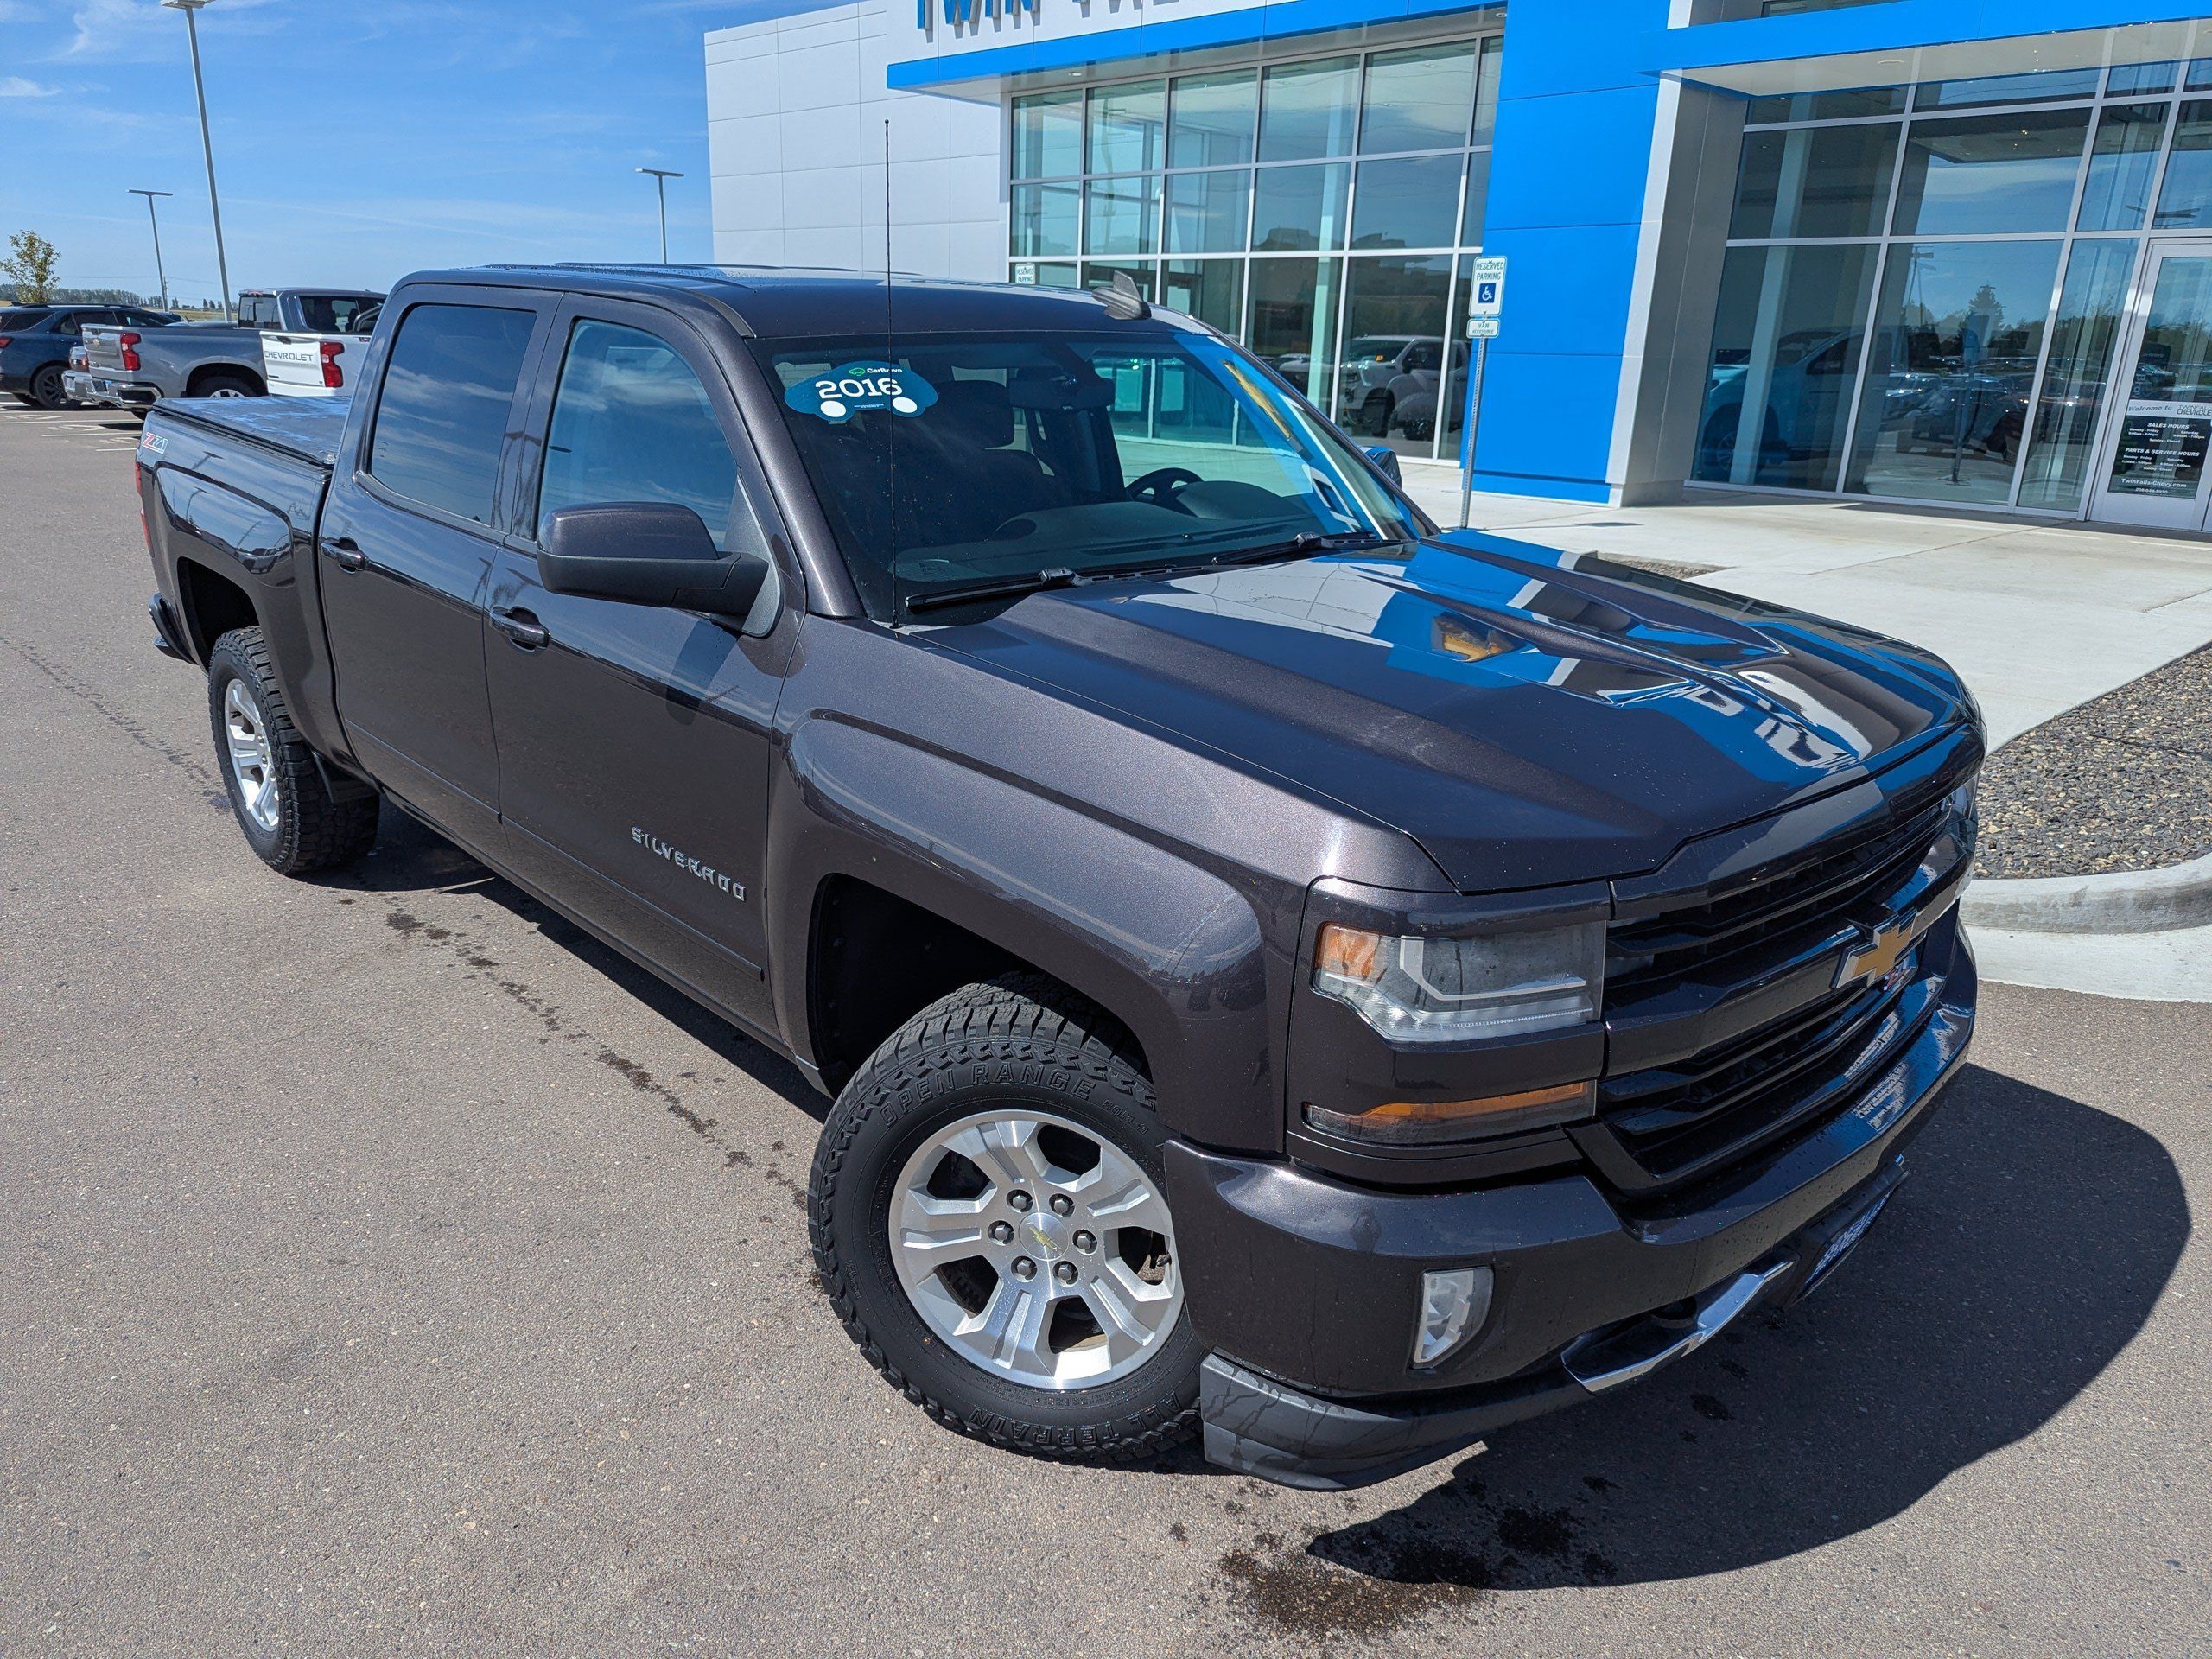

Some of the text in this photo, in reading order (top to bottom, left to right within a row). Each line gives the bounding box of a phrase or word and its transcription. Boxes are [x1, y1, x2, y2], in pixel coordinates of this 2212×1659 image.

[264, 350, 313, 361] CHEVROLET
[815, 378, 902, 398] 2016
[143, 432, 168, 454] Z71
[2121, 479, 2187, 487] TwinFalls-Chevy.com
[632, 826, 746, 902] SILVERADO
[880, 1061, 1096, 1126] OPEN RANGE
[1128, 1390, 1181, 1429] ALL
[969, 1408, 1120, 1446] TERRAIN
